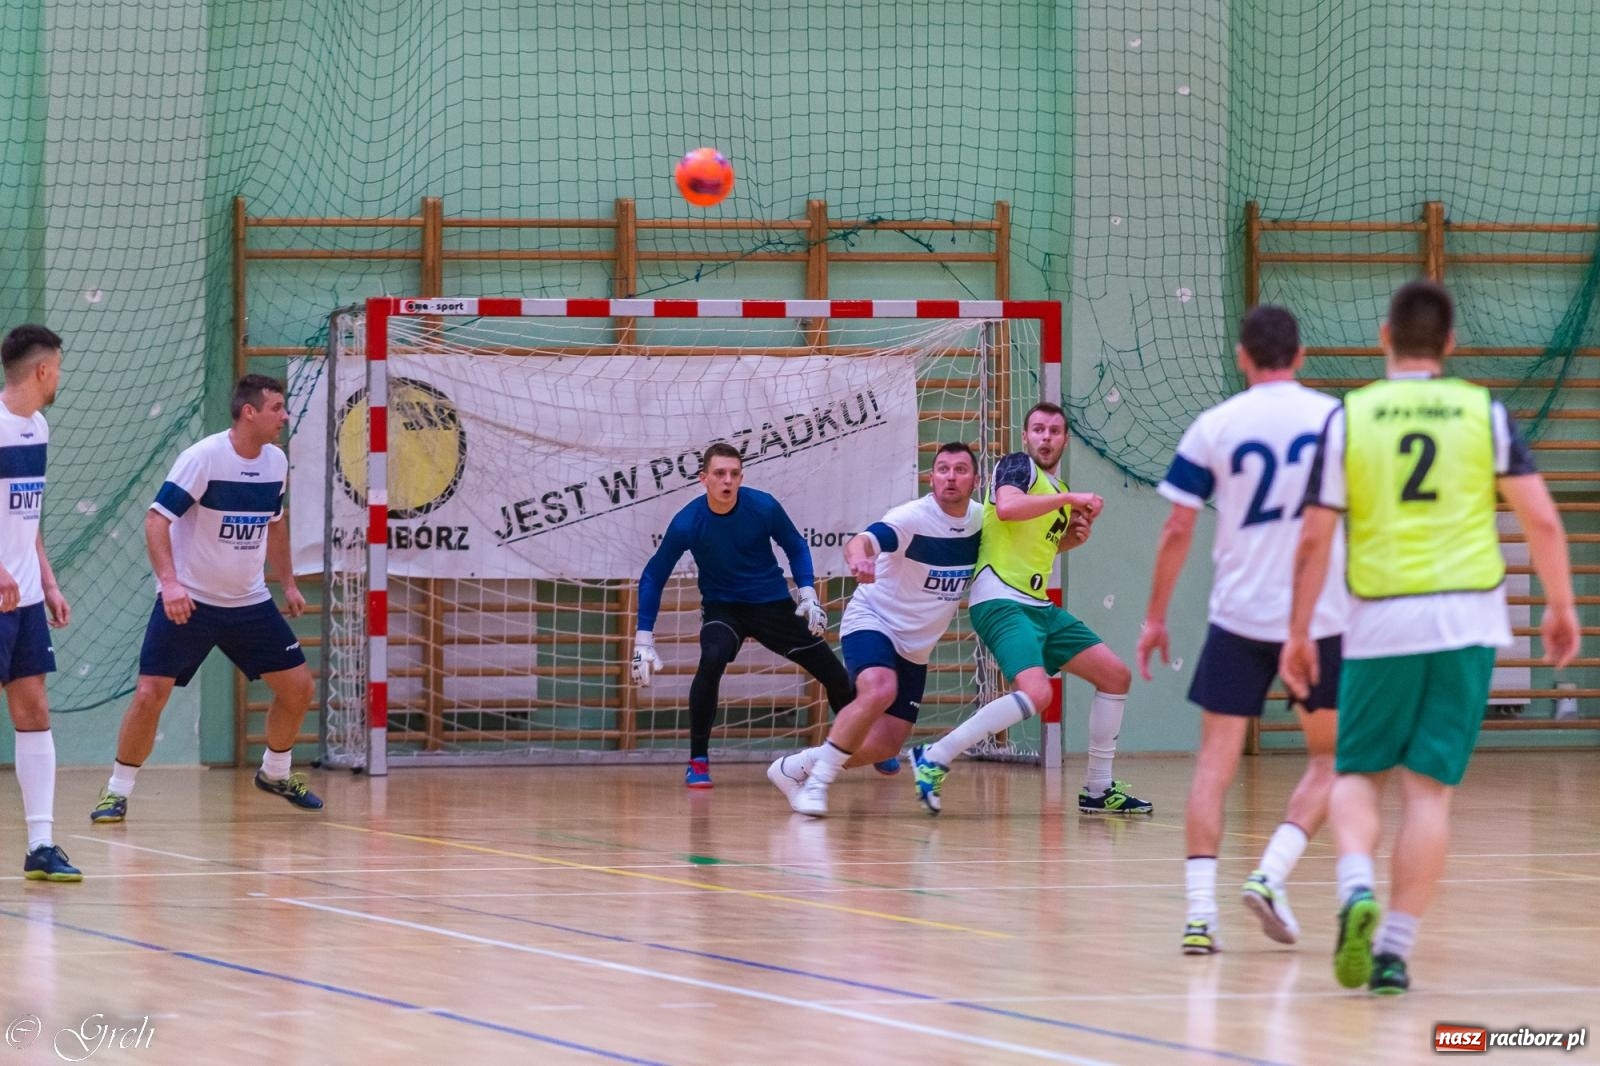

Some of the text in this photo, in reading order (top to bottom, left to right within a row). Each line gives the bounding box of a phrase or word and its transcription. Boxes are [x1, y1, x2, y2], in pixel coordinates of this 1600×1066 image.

[436, 302, 464, 312] sport
[494, 385, 882, 540] JEST W POZĄDKU!
[1399, 433, 1438, 502] 2
[10, 491, 42, 510] DWT
[219, 523, 266, 540] DWT
[332, 521, 470, 551] RAIBÓRZ
[930, 569, 971, 577] INSTA
[924, 576, 971, 592] DWT
